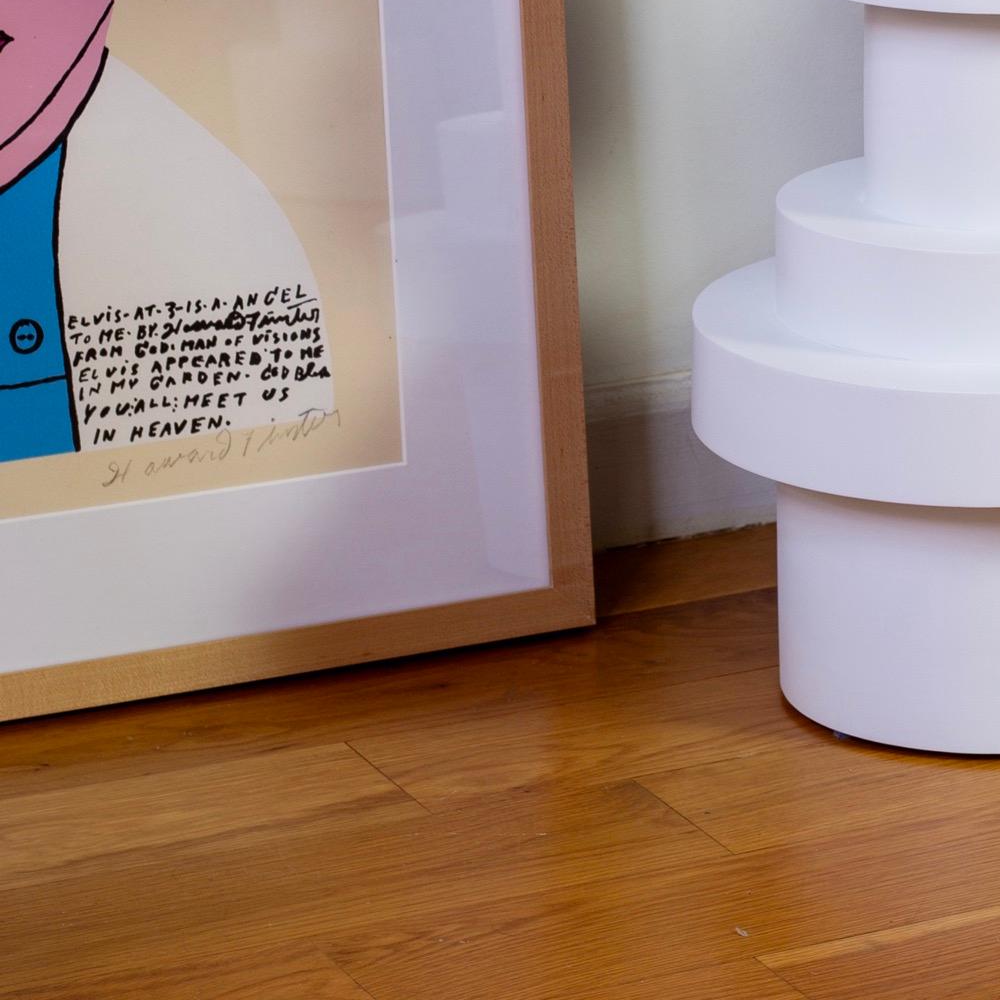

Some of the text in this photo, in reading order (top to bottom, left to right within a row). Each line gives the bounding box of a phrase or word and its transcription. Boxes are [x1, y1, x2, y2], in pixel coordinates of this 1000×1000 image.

[70, 333, 91, 345] TO
[73, 347, 123, 367] FROM
[181, 336, 217, 352] MAN
[225, 335, 244, 346] OF
[252, 327, 320, 345] VISIONS
[79, 345, 324, 382] ELVIS APPEARED TO ME
[79, 382, 101, 401] IN
[111, 378, 138, 395] MY
[260, 363, 289, 381] GOD
[184, 393, 247, 409] MEET
[262, 387, 290, 402] US
[93, 428, 116, 445] IN
